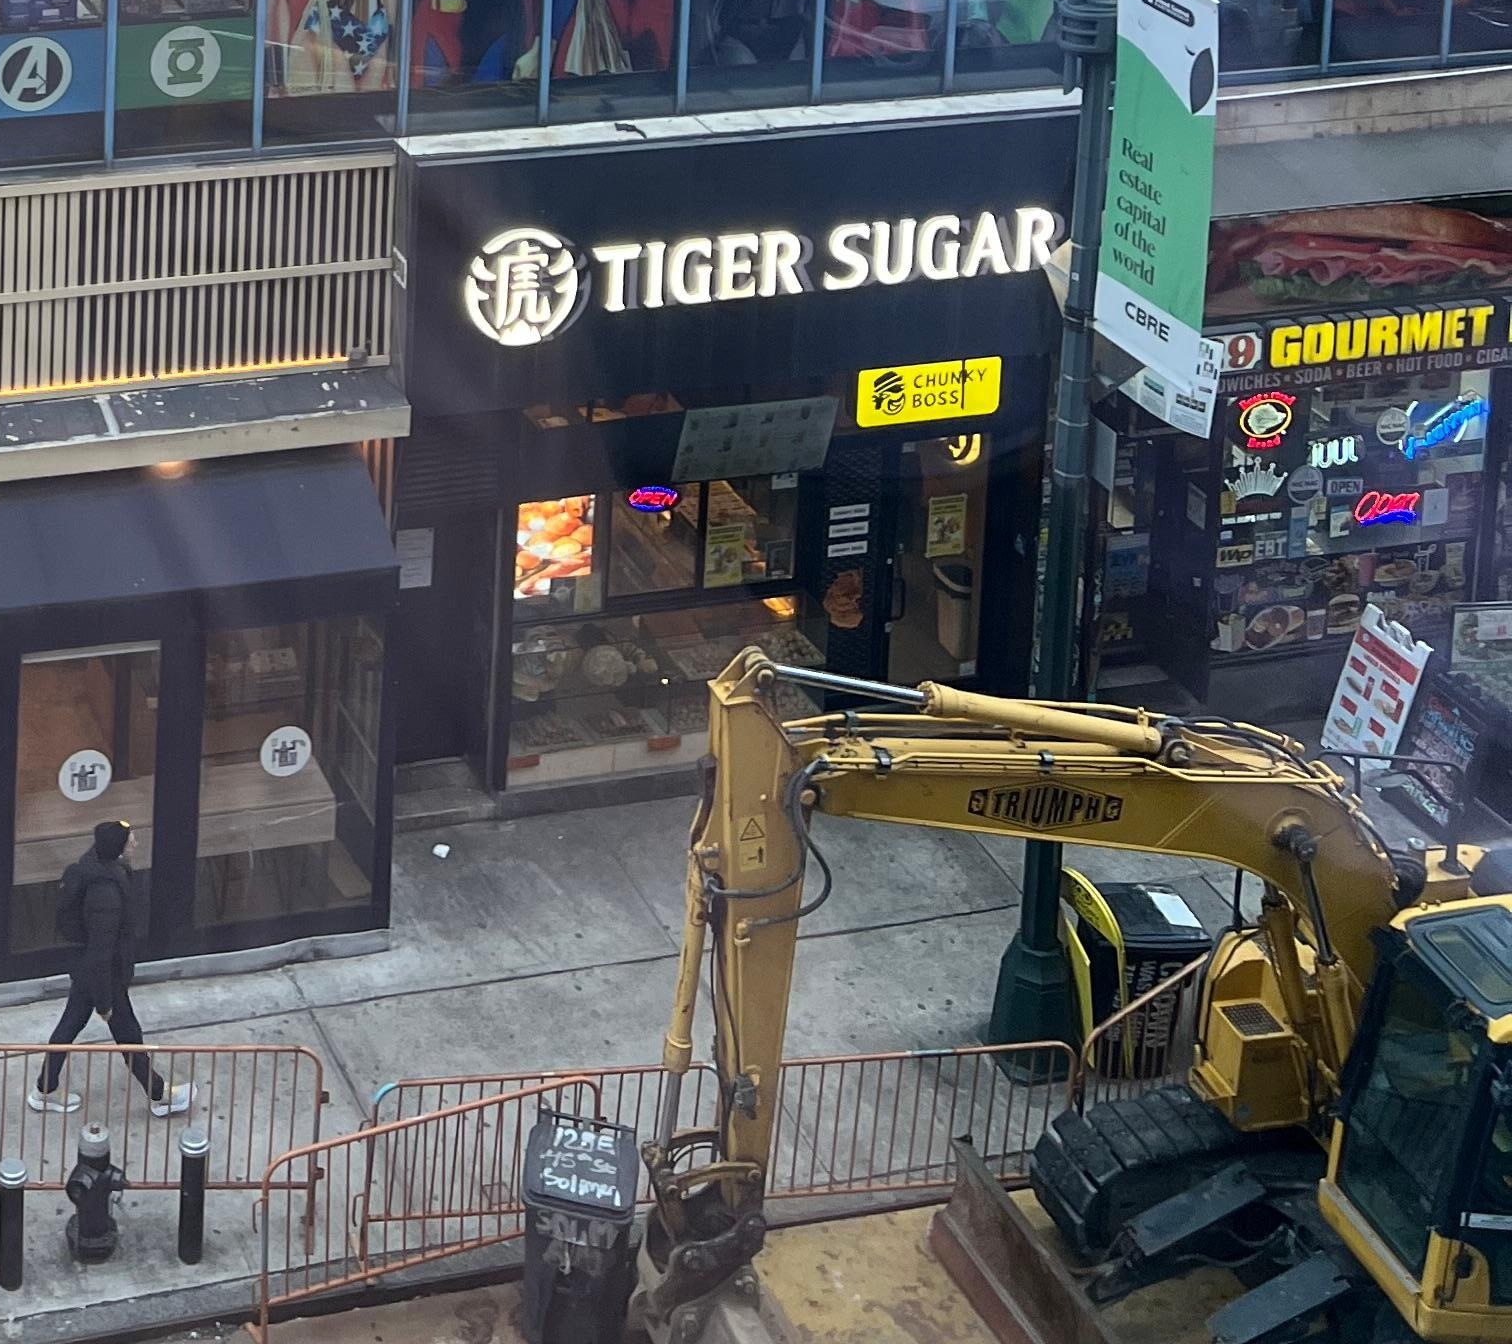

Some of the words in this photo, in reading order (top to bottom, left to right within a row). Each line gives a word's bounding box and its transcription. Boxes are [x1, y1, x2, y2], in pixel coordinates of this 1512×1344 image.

[1121, 137, 1154, 173] Real
[1119, 169, 1163, 206] estate
[1116, 194, 1167, 237] capital
[1114, 221, 1131, 241] of
[1131, 229, 1156, 258] the
[592, 231, 804, 312] TIGER
[824, 207, 1056, 292] SUGAR
[1112, 247, 1155, 287] world
[1124, 300, 1171, 343] CBRE
[1269, 305, 1495, 370] GOURMET
[913, 368, 988, 389] CHUNKY
[1294, 367, 1333, 385] SODA
[1345, 361, 1383, 379] BEER
[1396, 356, 1424, 373] HOT
[1426, 352, 1463, 370] FOOD
[912, 390, 959, 408] BOSS
[628, 489, 678, 507] OPEN
[1330, 481, 1360, 494] OPEN
[992, 784, 1100, 825] TRIUMPH
